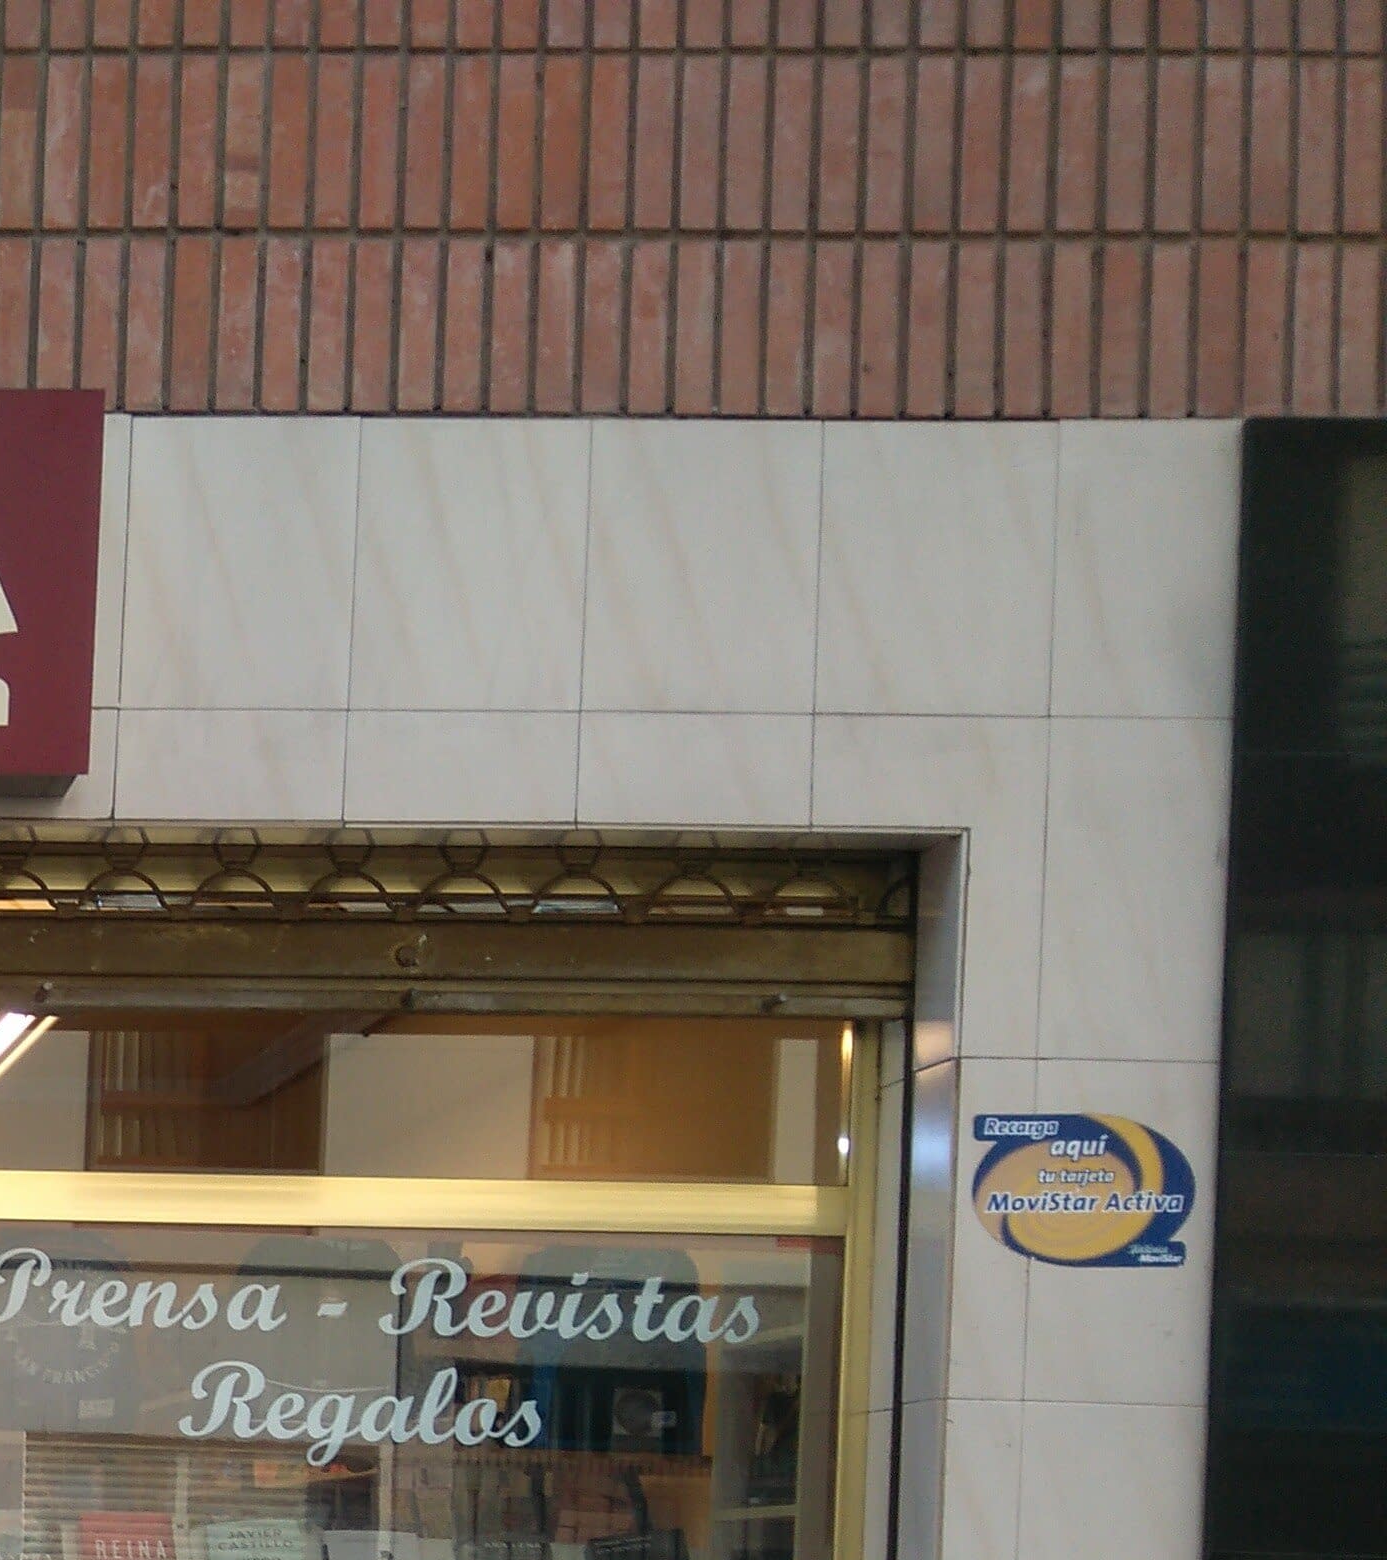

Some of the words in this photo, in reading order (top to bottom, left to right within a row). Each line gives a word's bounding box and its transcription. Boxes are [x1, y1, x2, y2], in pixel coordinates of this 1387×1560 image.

[984, 1118, 1059, 1138] Recarga
[1050, 1134, 1109, 1162] aquí
[1038, 1169, 1056, 1183] tu
[1061, 1168, 1115, 1187] tarjeta
[985, 1192, 1097, 1213] MoviStar
[1103, 1193, 1184, 1213] Activa
[377, 1256, 761, 1346] Revistas
[178, 1359, 543, 1468] Regalos
[95, 1539, 168, 1560] REINA
